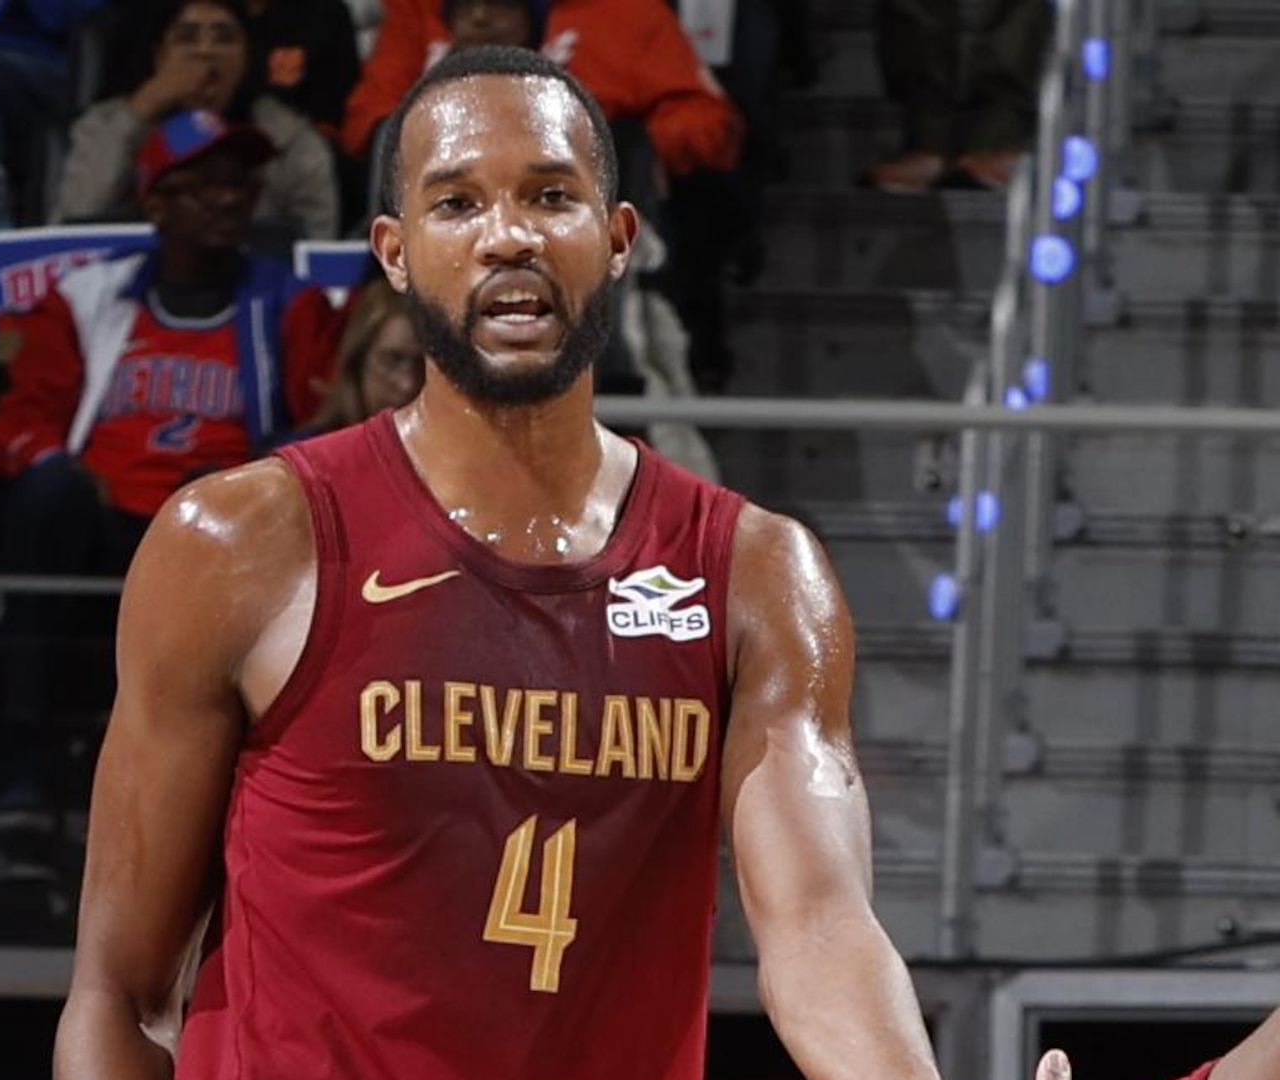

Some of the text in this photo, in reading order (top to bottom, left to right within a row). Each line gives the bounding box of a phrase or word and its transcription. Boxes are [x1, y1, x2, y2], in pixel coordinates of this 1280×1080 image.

[104, 355, 246, 417] ETROI
[148, 414, 198, 452] 2
[611, 609, 705, 633] CLIFFS
[359, 679, 710, 783] CLEVELAND
[483, 814, 578, 994] 4
